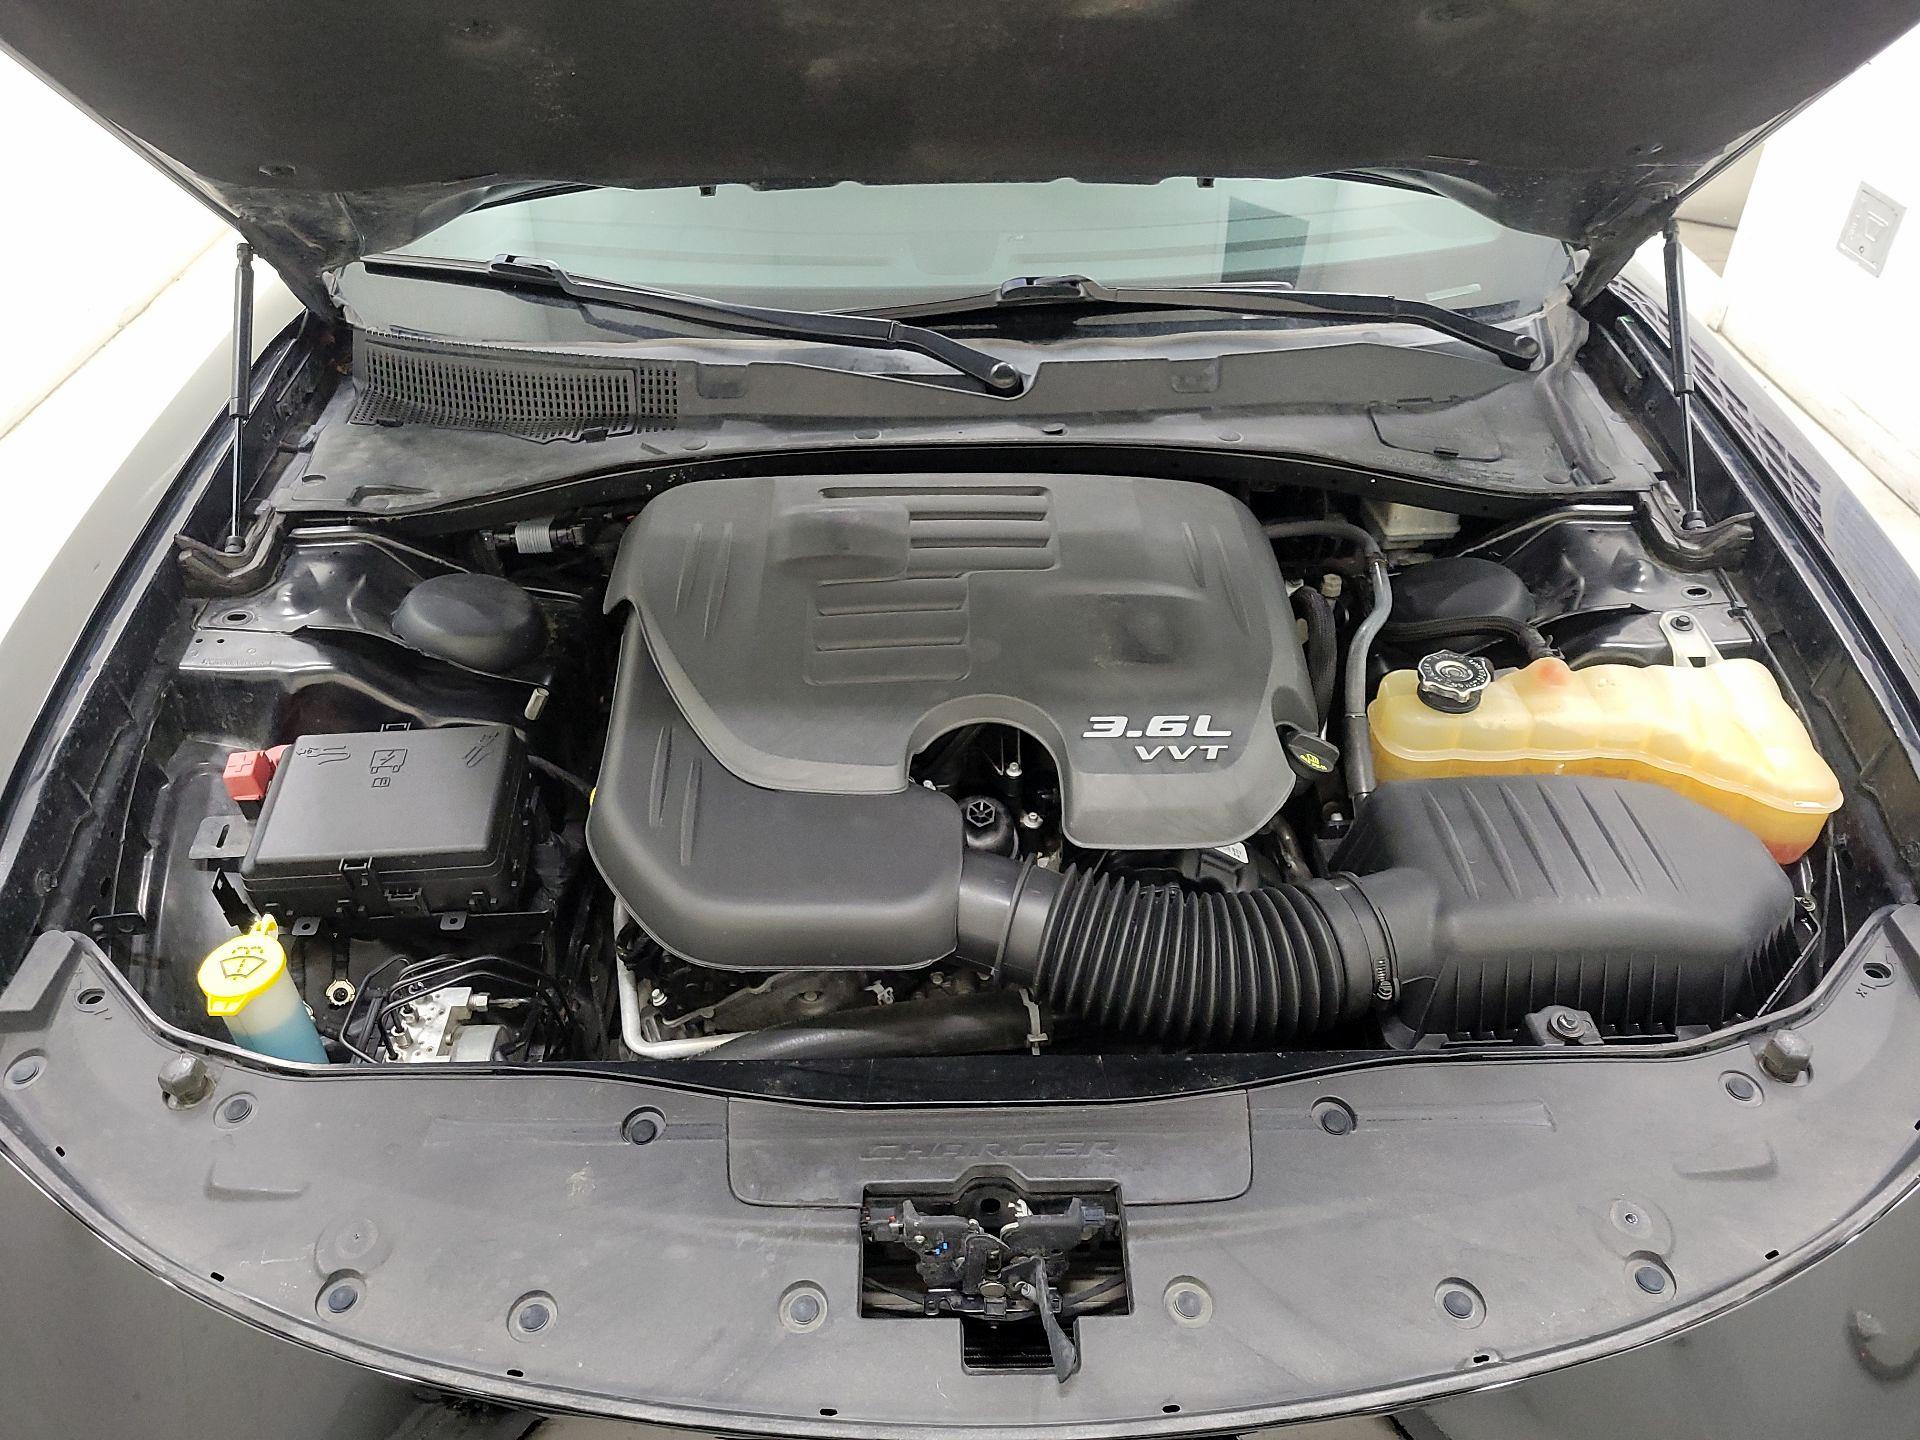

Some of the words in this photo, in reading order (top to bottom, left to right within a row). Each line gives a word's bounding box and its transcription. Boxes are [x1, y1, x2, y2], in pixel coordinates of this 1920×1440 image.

[1082, 714, 1232, 738] 3.6L
[1134, 745, 1229, 761] VVT
[858, 1142, 1120, 1160] CHARGER
